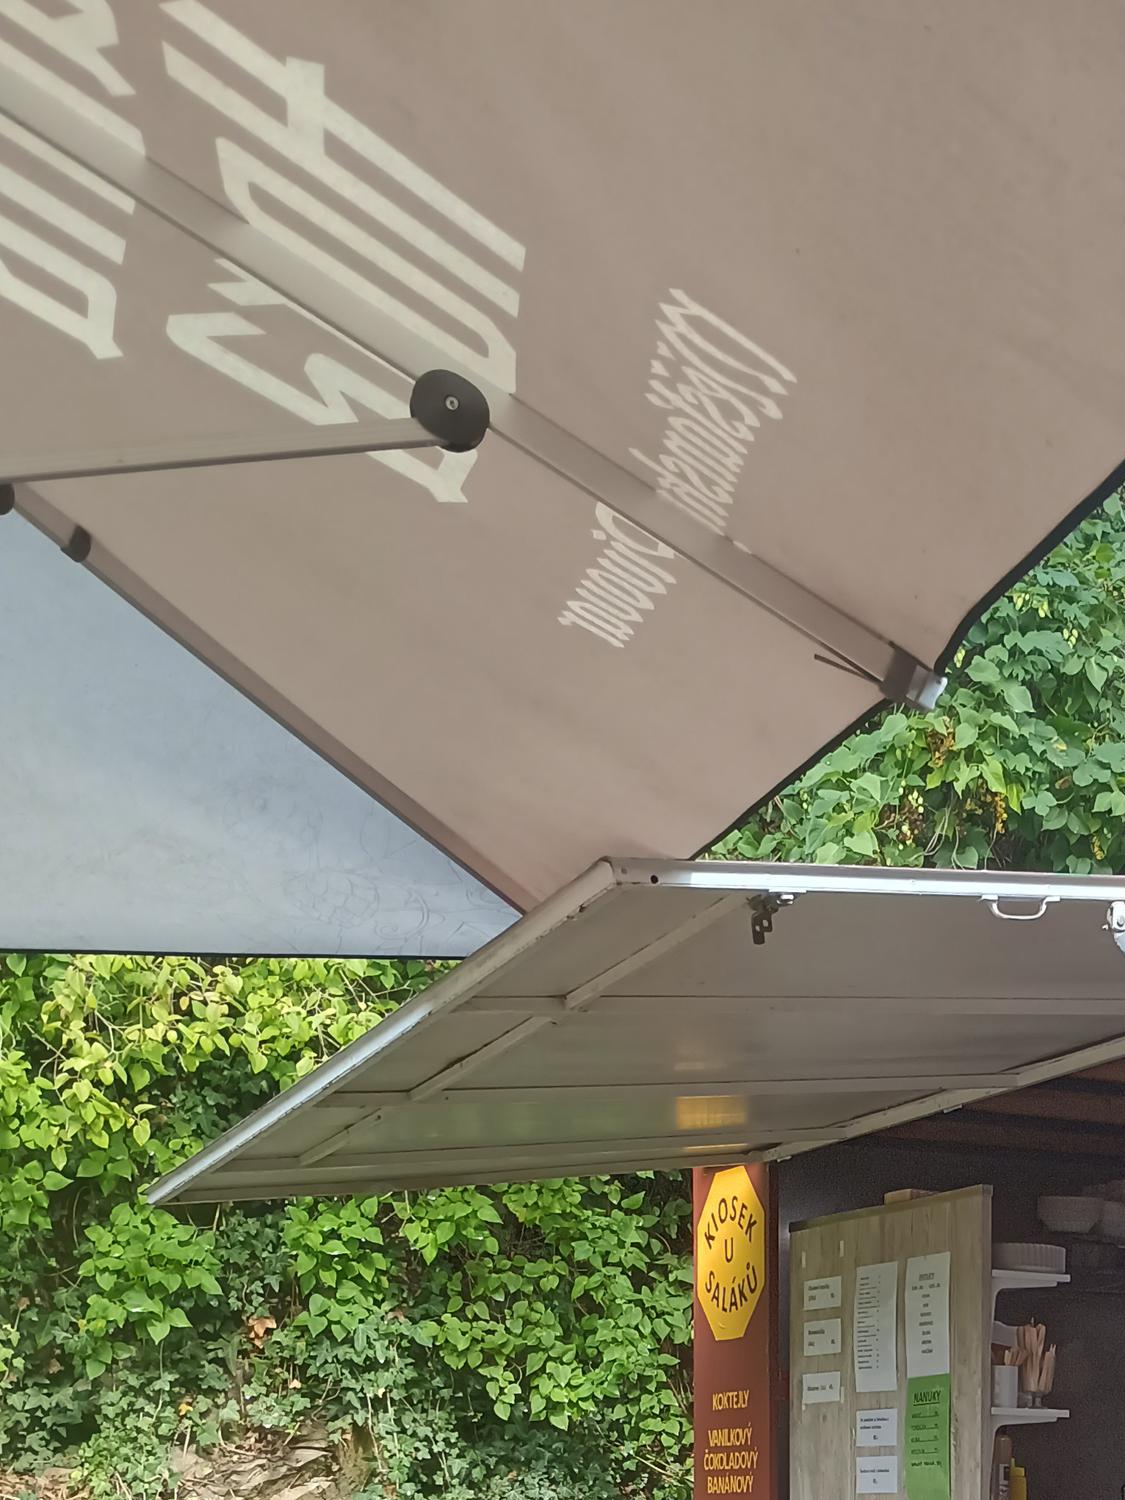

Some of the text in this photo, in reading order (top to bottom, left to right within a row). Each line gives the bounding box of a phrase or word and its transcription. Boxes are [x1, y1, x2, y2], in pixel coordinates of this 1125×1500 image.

[704, 1195, 757, 1250] KIOSEK
[723, 1237, 734, 1263] U
[704, 1264, 758, 1313] SALÁKŮ
[712, 1390, 750, 1411] KOKTEJLY
[914, 1389, 941, 1403] NANUKY
[708, 1422, 752, 1447] VANILKOVÝ
[703, 1447, 758, 1470] ČOKOLADOVÝ
[707, 1472, 753, 1494] BANÁNOVÝ
